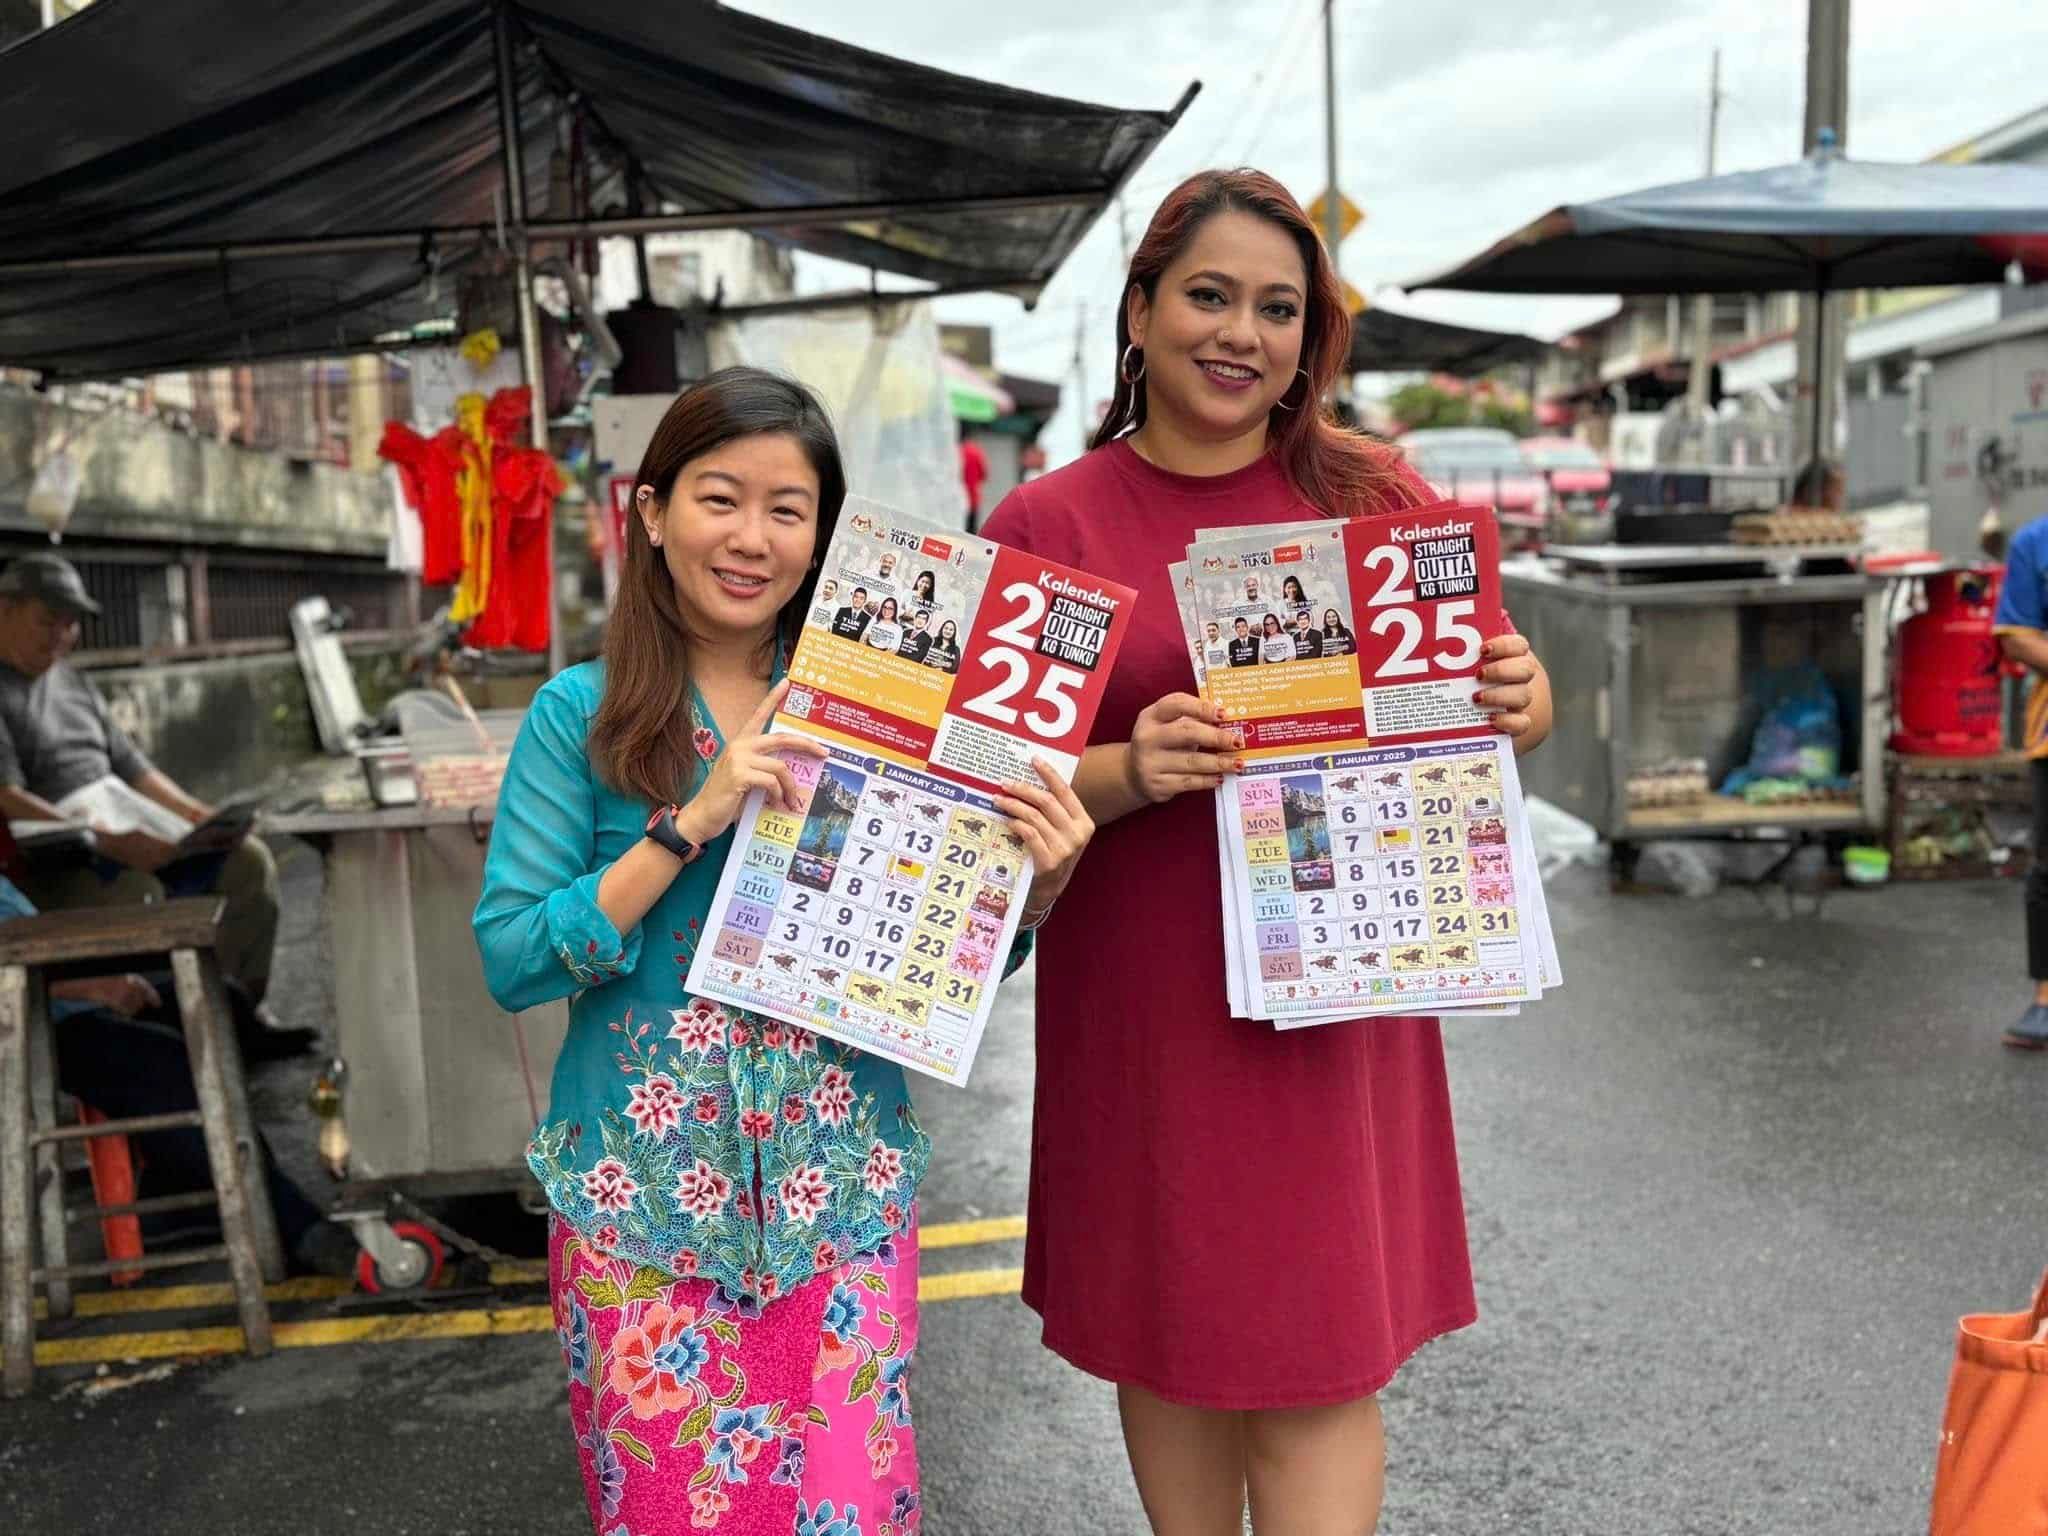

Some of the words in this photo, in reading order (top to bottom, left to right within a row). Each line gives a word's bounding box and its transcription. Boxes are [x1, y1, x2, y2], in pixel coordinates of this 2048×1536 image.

[1390, 520, 1473, 542] Kalendar
[1415, 537, 1470, 557] STRAIGHT
[1364, 546, 1414, 606] 2
[1418, 555, 1472, 580] OUTTA
[1038, 571, 1119, 609] Kalendar
[1421, 583, 1435, 596] KG
[1438, 578, 1473, 594] TUNKU
[988, 583, 1045, 650] 2
[1054, 598, 1110, 626] STRAIGHT
[1048, 615, 1100, 649] OUTTA
[1370, 600, 1483, 677] 25
[1042, 638, 1058, 653] KG
[1060, 643, 1094, 666] TUNKU
[963, 647, 1086, 737] 25
[782, 759, 813, 779] SUN
[1323, 757, 1334, 769] 1
[1336, 754, 1380, 765] JANUARY
[1383, 752, 1406, 760] 2025
[874, 761, 886, 776] 1
[886, 769, 931, 788] JANUARY
[932, 784, 955, 796] 2025
[1244, 788, 1273, 800] SUN
[1342, 806, 1356, 823] 6
[1378, 802, 1407, 819] 13
[1422, 798, 1452, 816] 20
[761, 818, 794, 839] TUE
[868, 818, 883, 836] 6
[1246, 817, 1280, 829] MON
[905, 830, 933, 853] 13
[1345, 835, 1358, 852] 7
[1426, 826, 1453, 844] 21
[750, 848, 785, 869] WED
[859, 847, 874, 865] 7
[944, 844, 976, 868] 20
[1252, 846, 1282, 857] TUE
[1350, 864, 1364, 881] 8
[1386, 860, 1415, 878] 15
[1430, 856, 1460, 874] 22
[740, 878, 775, 899] THU
[847, 878, 862, 896] 8
[934, 874, 964, 897] 21
[1255, 874, 1287, 886] WED
[792, 893, 810, 912] 2
[886, 890, 914, 913] 15
[1353, 894, 1367, 910] 9
[1390, 890, 1418, 907] 16
[1433, 886, 1463, 904] 23
[1258, 904, 1290, 915] THU
[1310, 897, 1324, 914] 2
[734, 910, 760, 928] FRI
[837, 908, 852, 925] 9
[924, 904, 956, 929] 22
[1436, 915, 1467, 934] 24
[1481, 912, 1508, 930] 31
[784, 923, 799, 941] 3
[876, 920, 904, 943] 16
[1314, 927, 1327, 943] 3
[1350, 922, 1378, 940] 10
[1393, 919, 1421, 937] 17
[822, 936, 850, 958] 10
[914, 934, 945, 958] 23
[1266, 933, 1289, 944] FRI
[722, 939, 752, 959] SAT
[866, 950, 894, 972] 17
[1268, 962, 1294, 973] SAT
[904, 964, 934, 988] 24
[946, 980, 974, 1003] 31
